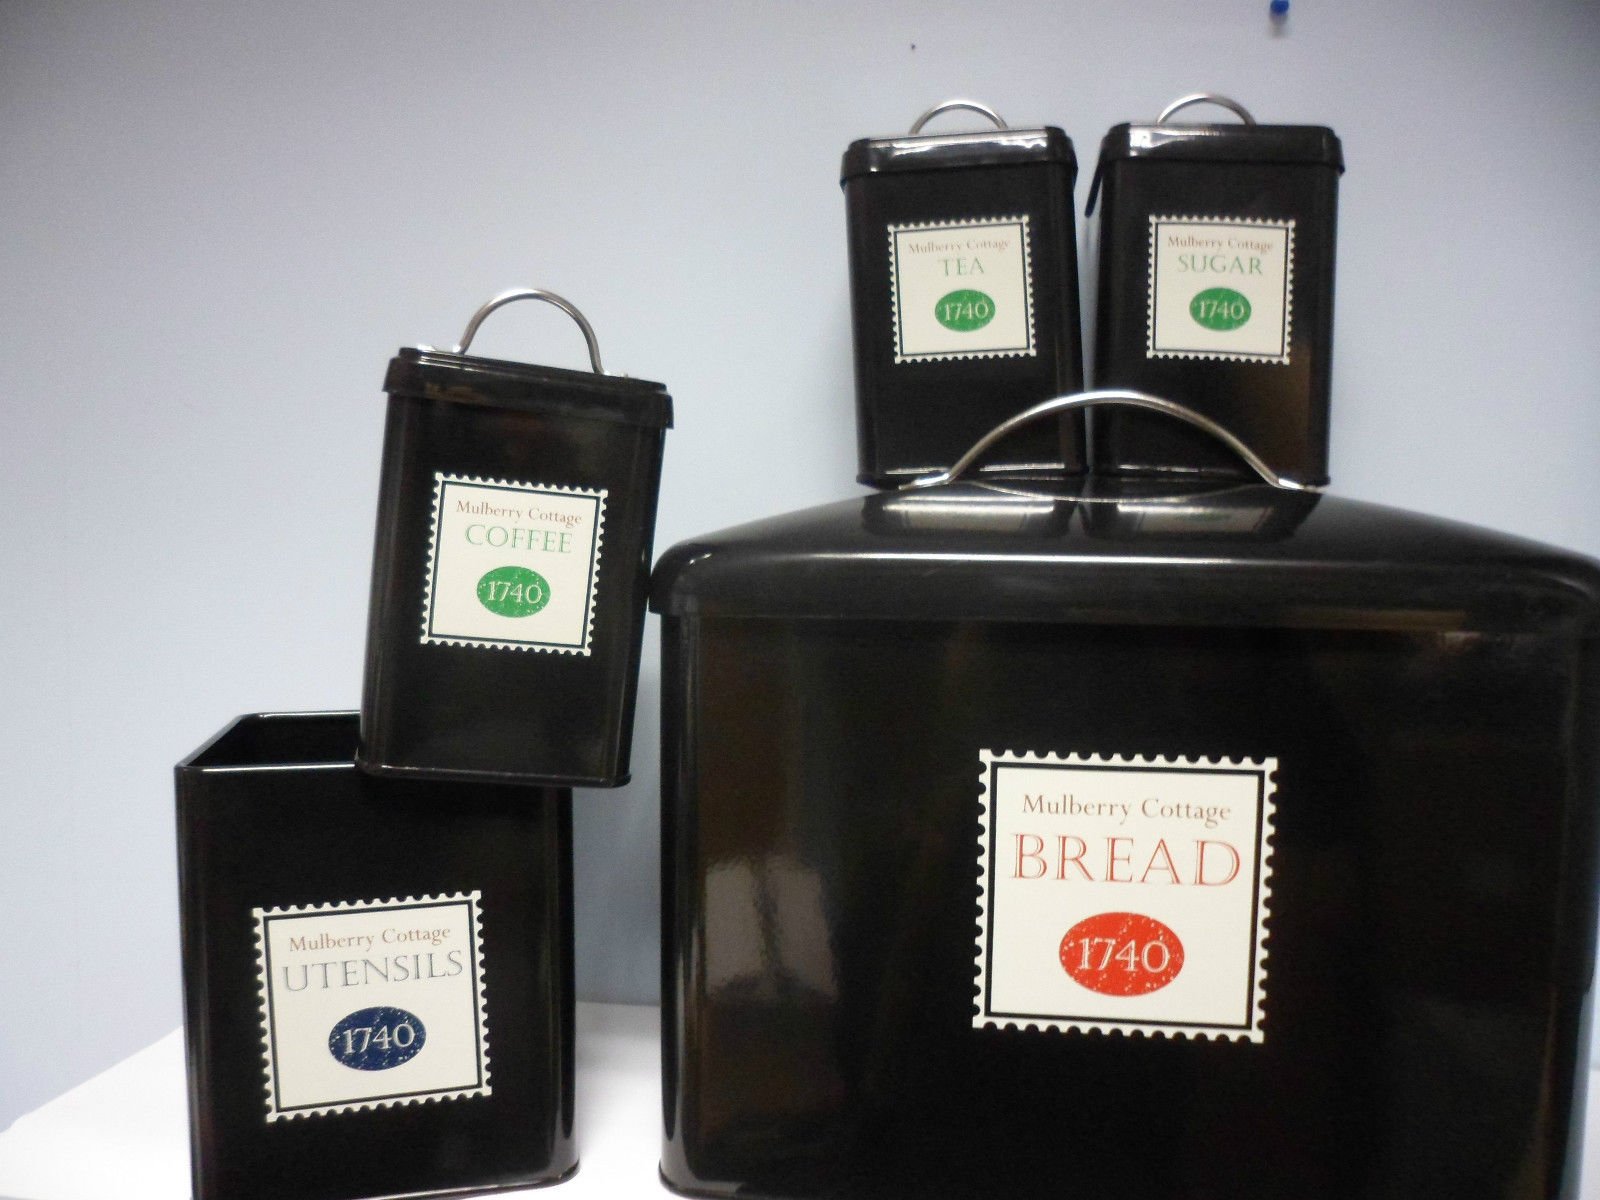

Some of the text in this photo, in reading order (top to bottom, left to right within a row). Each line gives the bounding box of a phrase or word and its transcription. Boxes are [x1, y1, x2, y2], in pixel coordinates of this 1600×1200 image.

[1167, 235, 1222, 251] Mulberry
[937, 257, 985, 277] TEA
[1177, 254, 1263, 275] SUGAR
[943, 302, 989, 321] 1740
[1199, 300, 1245, 321] 1740
[456, 500, 582, 528] Mulberry Cottage
[465, 524, 573, 553] COFFEE
[487, 581, 543, 604] 1740
[1022, 794, 1231, 828] Mulberry Cottage
[1009, 833, 1241, 887] BREAD
[289, 927, 451, 952] Mulberry Cottage
[1078, 937, 1171, 973] 1740
[282, 950, 463, 992] UTENSILS
[342, 1024, 416, 1055] 1740
